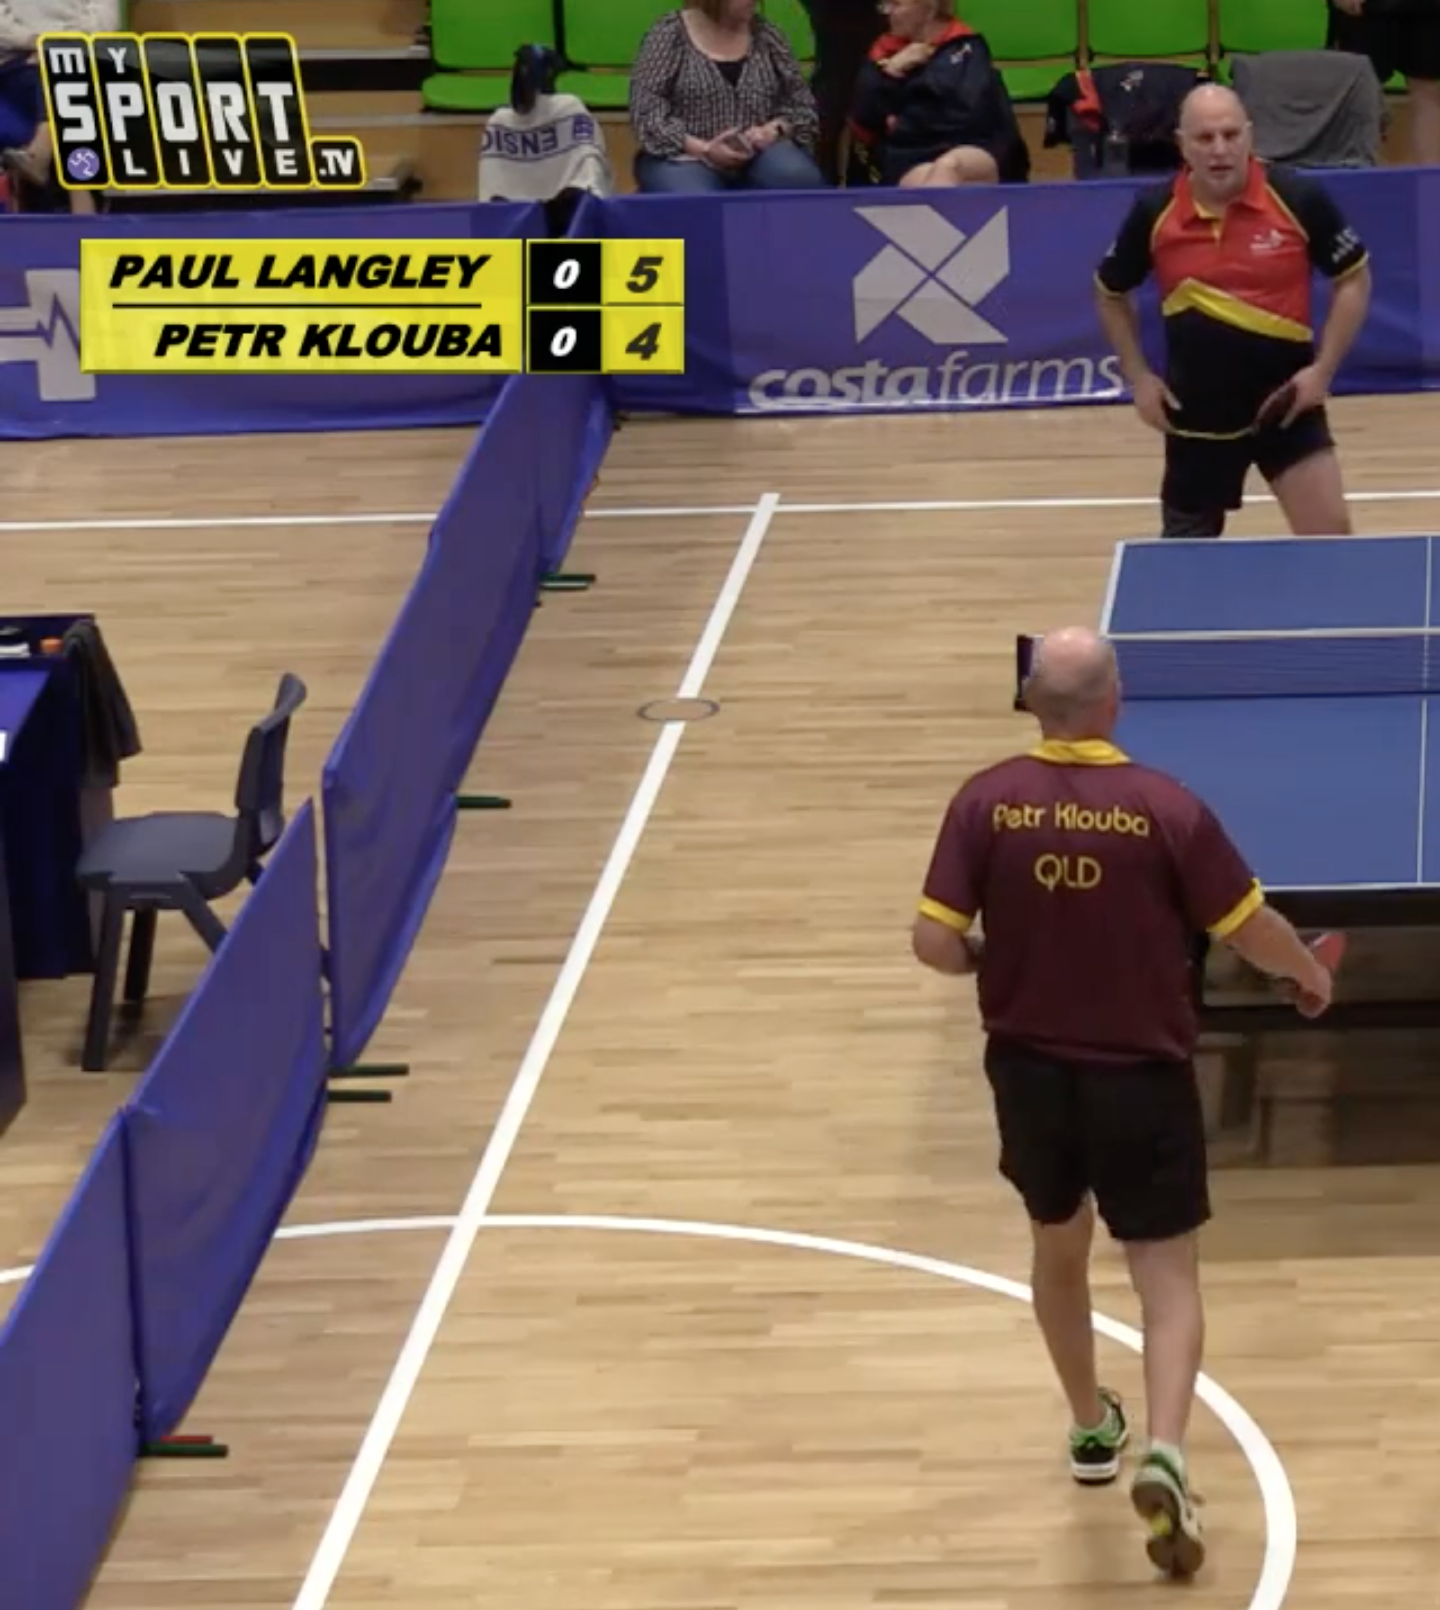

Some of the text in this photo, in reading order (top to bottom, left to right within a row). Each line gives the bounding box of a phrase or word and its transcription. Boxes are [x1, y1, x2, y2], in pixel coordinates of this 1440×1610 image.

[992, 802, 1149, 837] Petr Klouba
[1034, 854, 1102, 892] QLD
